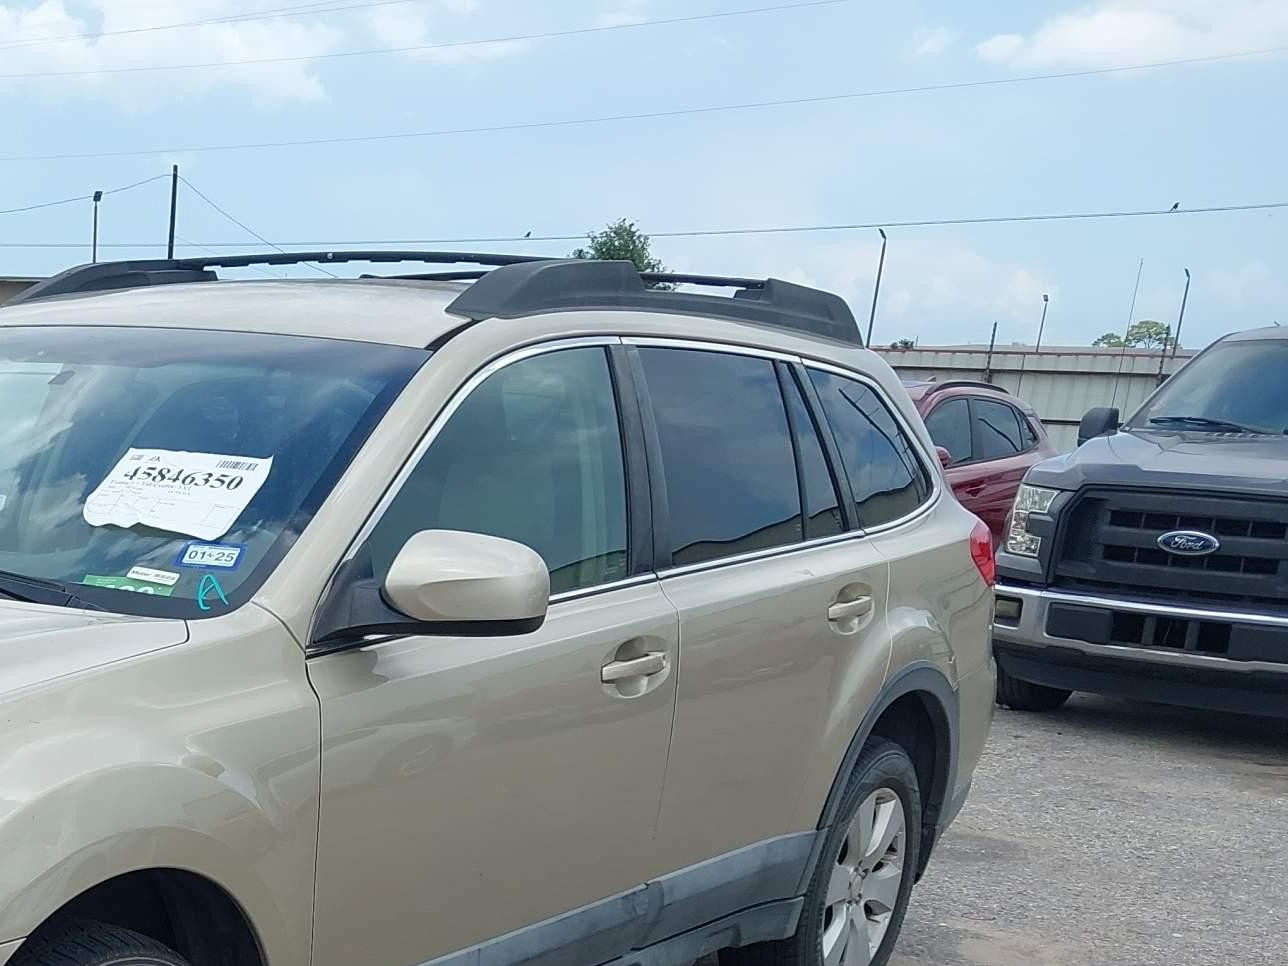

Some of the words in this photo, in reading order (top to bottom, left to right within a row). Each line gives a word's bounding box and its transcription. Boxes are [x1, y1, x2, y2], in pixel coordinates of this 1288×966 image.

[123, 465, 244, 491] 45846350
[1171, 535, 1204, 550] Ford
[188, 550, 207, 561] 01
[214, 551, 236, 563] 25
